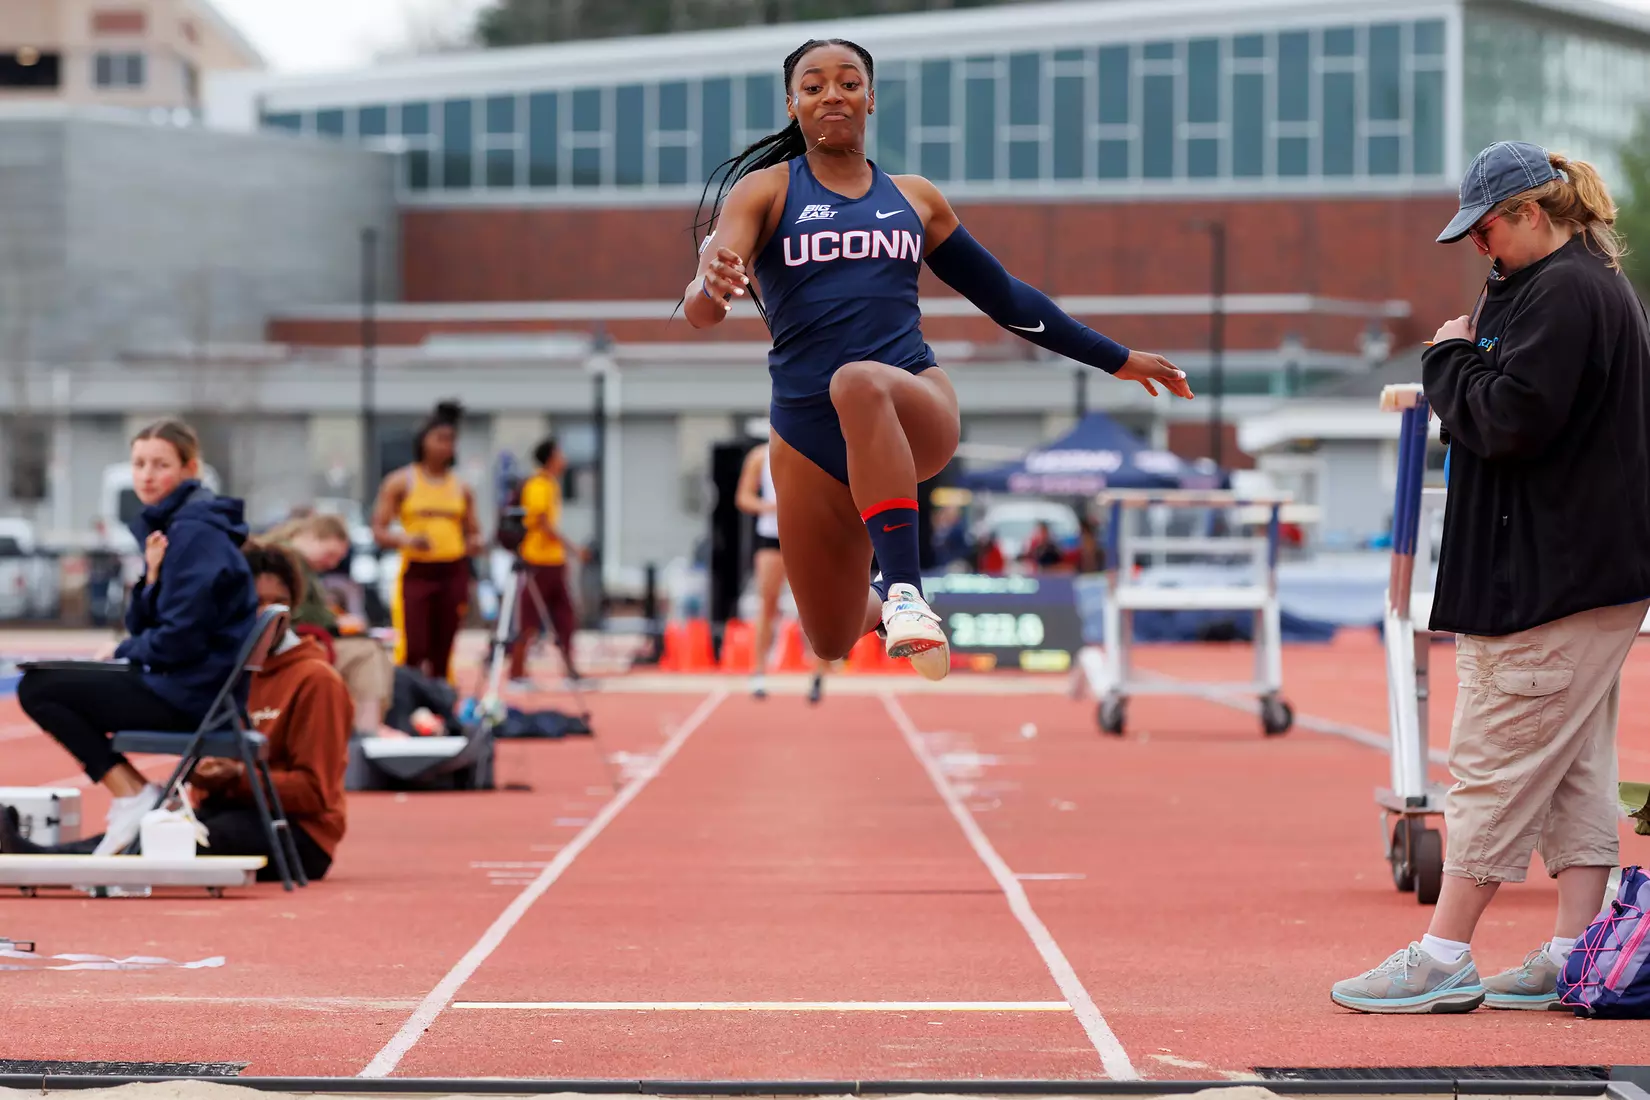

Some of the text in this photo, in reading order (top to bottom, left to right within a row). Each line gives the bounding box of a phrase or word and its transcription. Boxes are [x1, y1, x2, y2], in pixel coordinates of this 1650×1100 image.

[804, 204, 831, 212] BIG
[798, 210, 839, 219] EAST
[783, 229, 921, 267] UCONN
